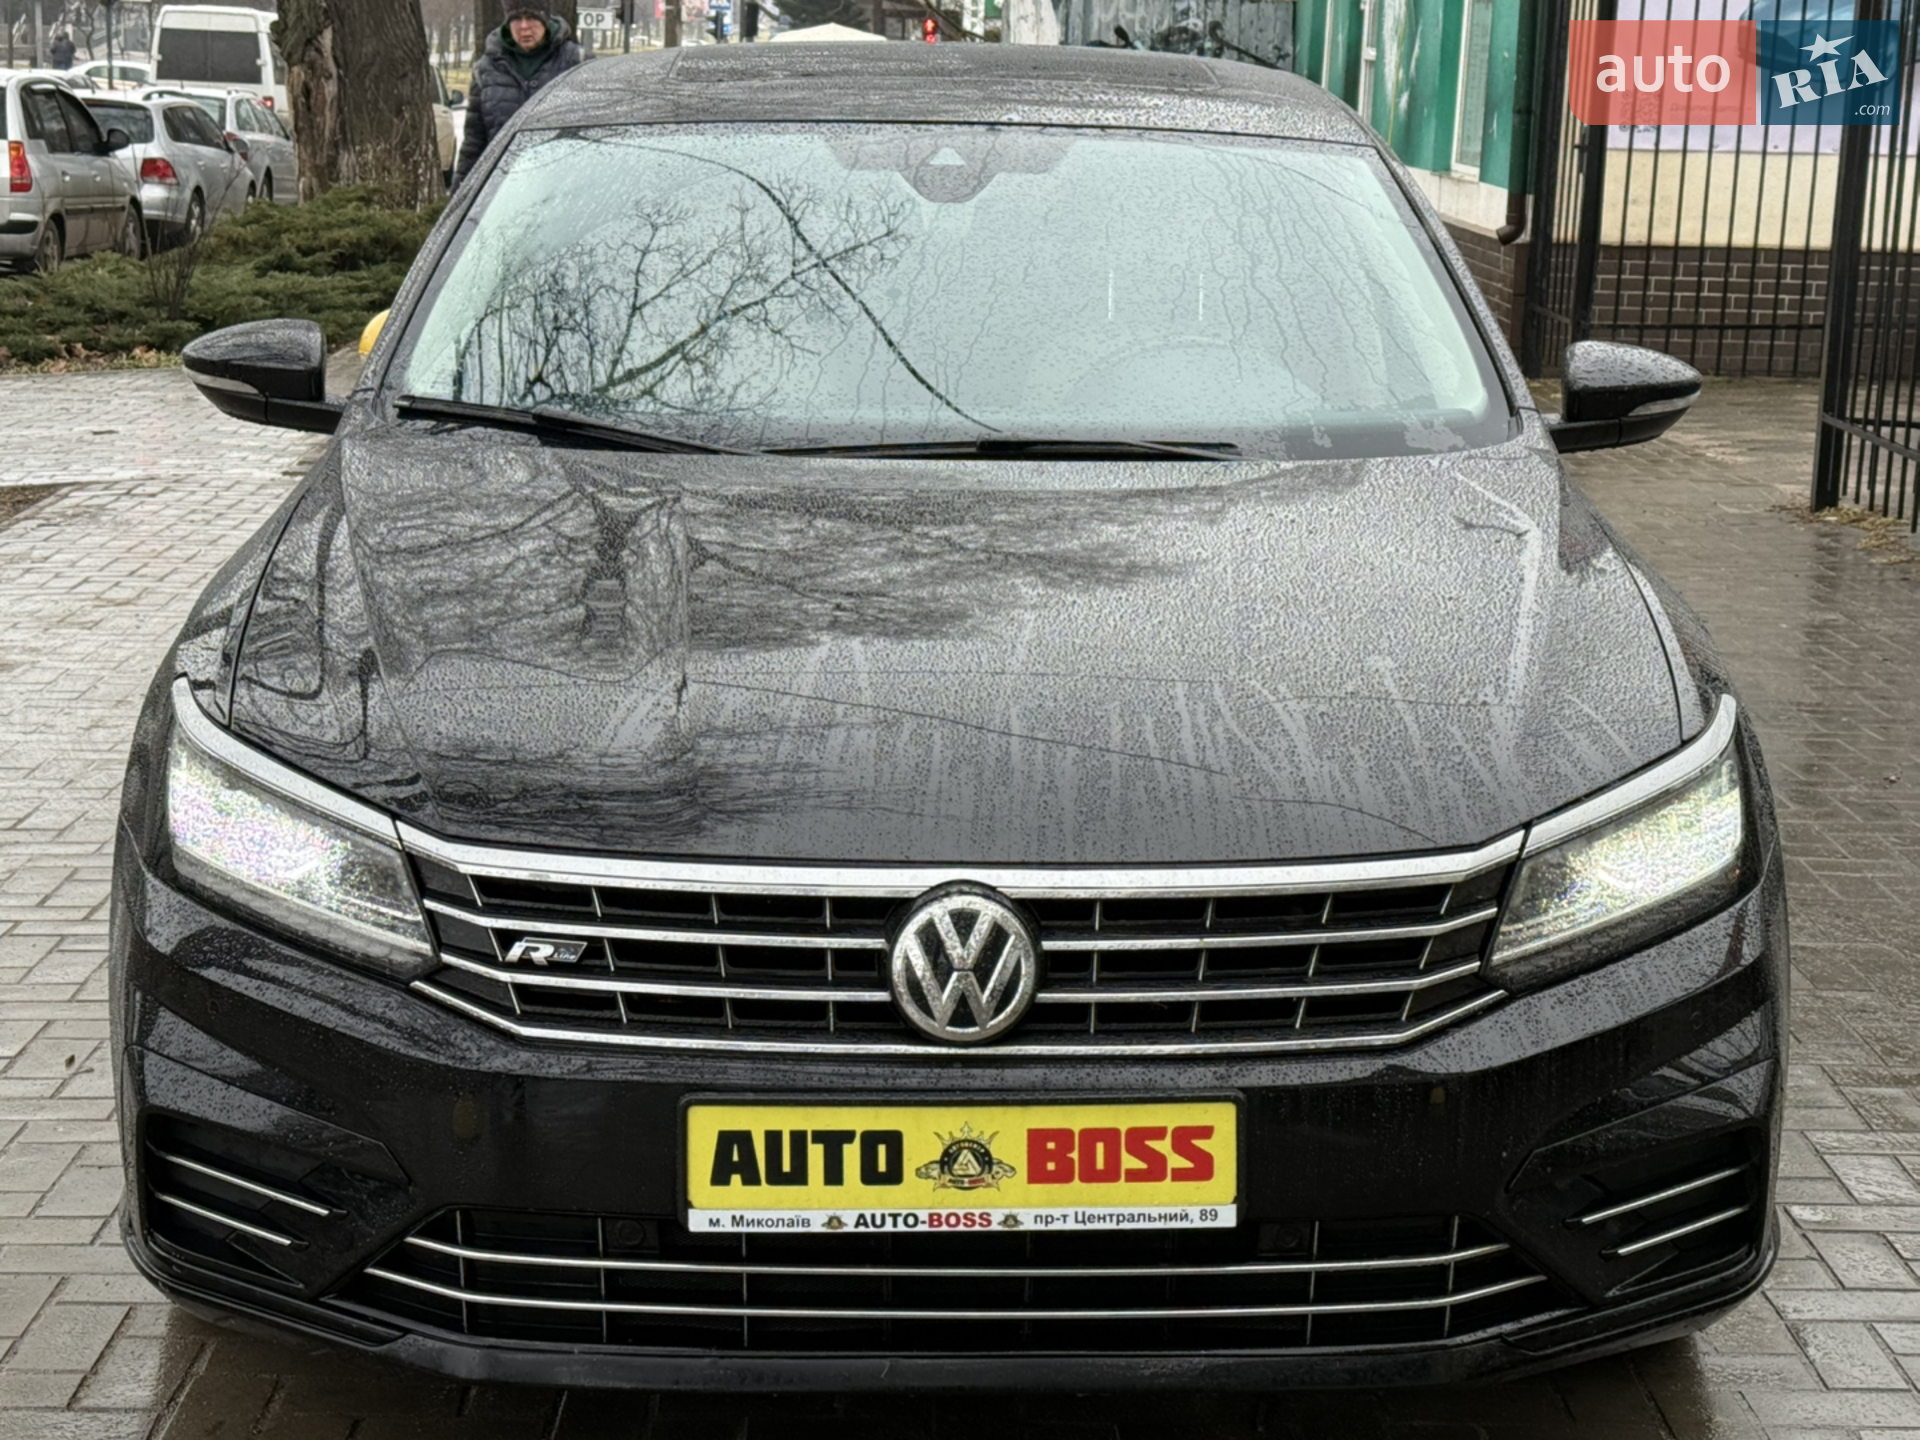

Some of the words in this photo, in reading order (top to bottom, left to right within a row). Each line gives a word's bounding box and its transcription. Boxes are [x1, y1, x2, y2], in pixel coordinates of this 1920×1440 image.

[576, 12, 605, 27] TOP
[711, 1130, 904, 1186] AUTO
[1026, 1126, 1214, 1185] BOSS
[708, 1217, 725, 1228] м.
[731, 1214, 811, 1229] Миколаїв
[853, 1212, 993, 1229] AUTO-BOSS
[1033, 1214, 1069, 1228] пр-т
[1074, 1209, 1194, 1226] Центральний,
[1199, 1208, 1219, 1222] 89
